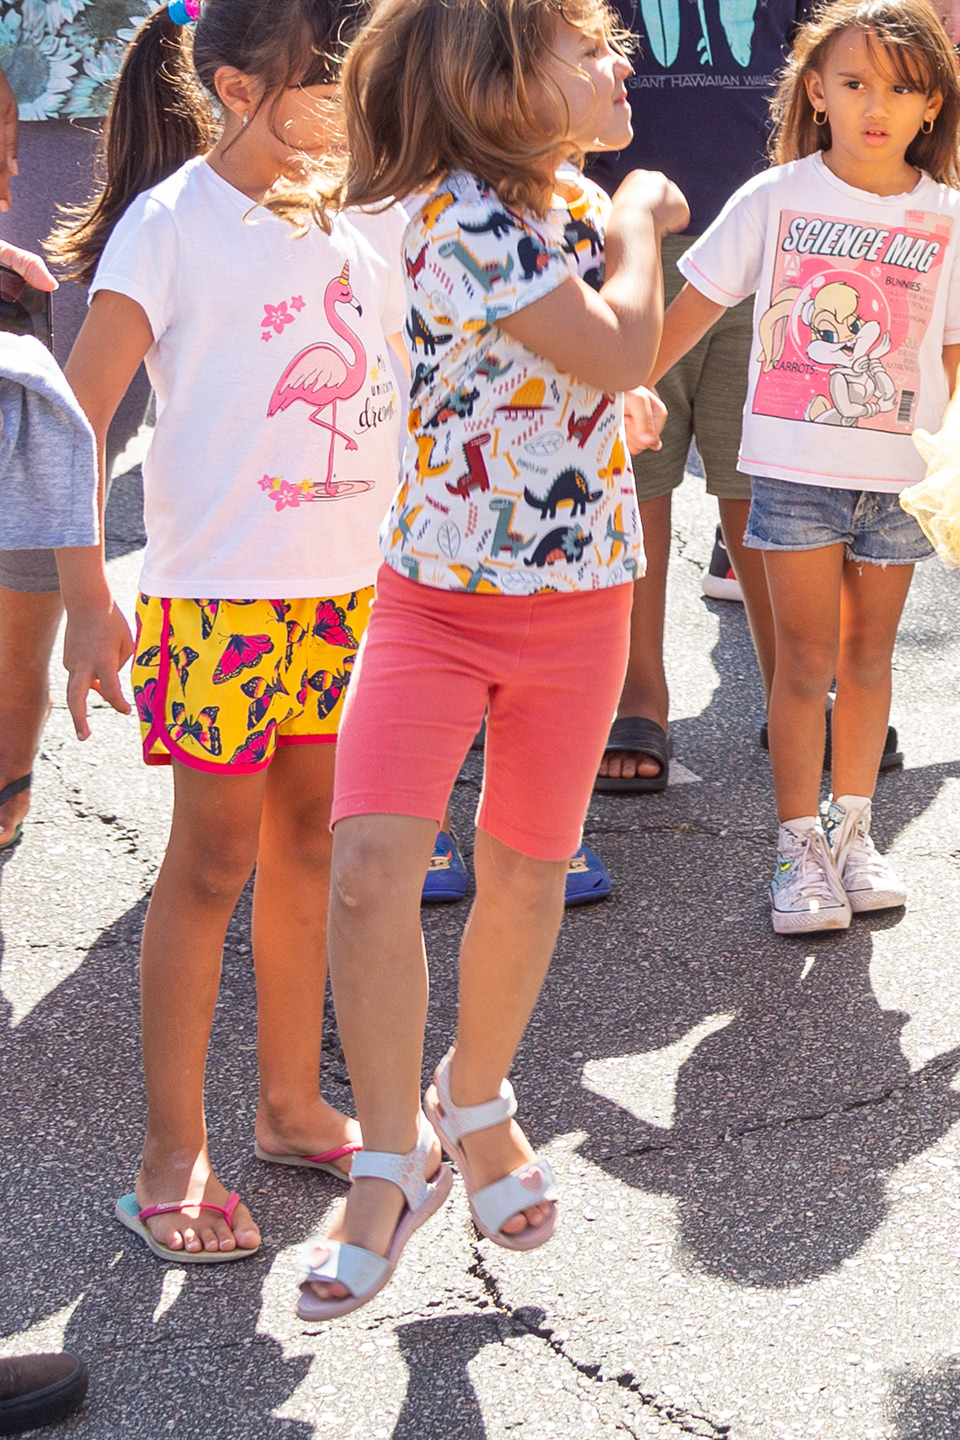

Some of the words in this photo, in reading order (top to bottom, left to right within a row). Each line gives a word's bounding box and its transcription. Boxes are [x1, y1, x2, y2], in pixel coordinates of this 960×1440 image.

[628, 76, 666, 89] GIANT
[671, 75, 740, 88] HAWAIIAN
[782, 217, 889, 262] SCIENCE
[883, 233, 941, 274] MAG
[885, 276, 921, 292] BUNNIES
[772, 359, 818, 376] CARROTS:
